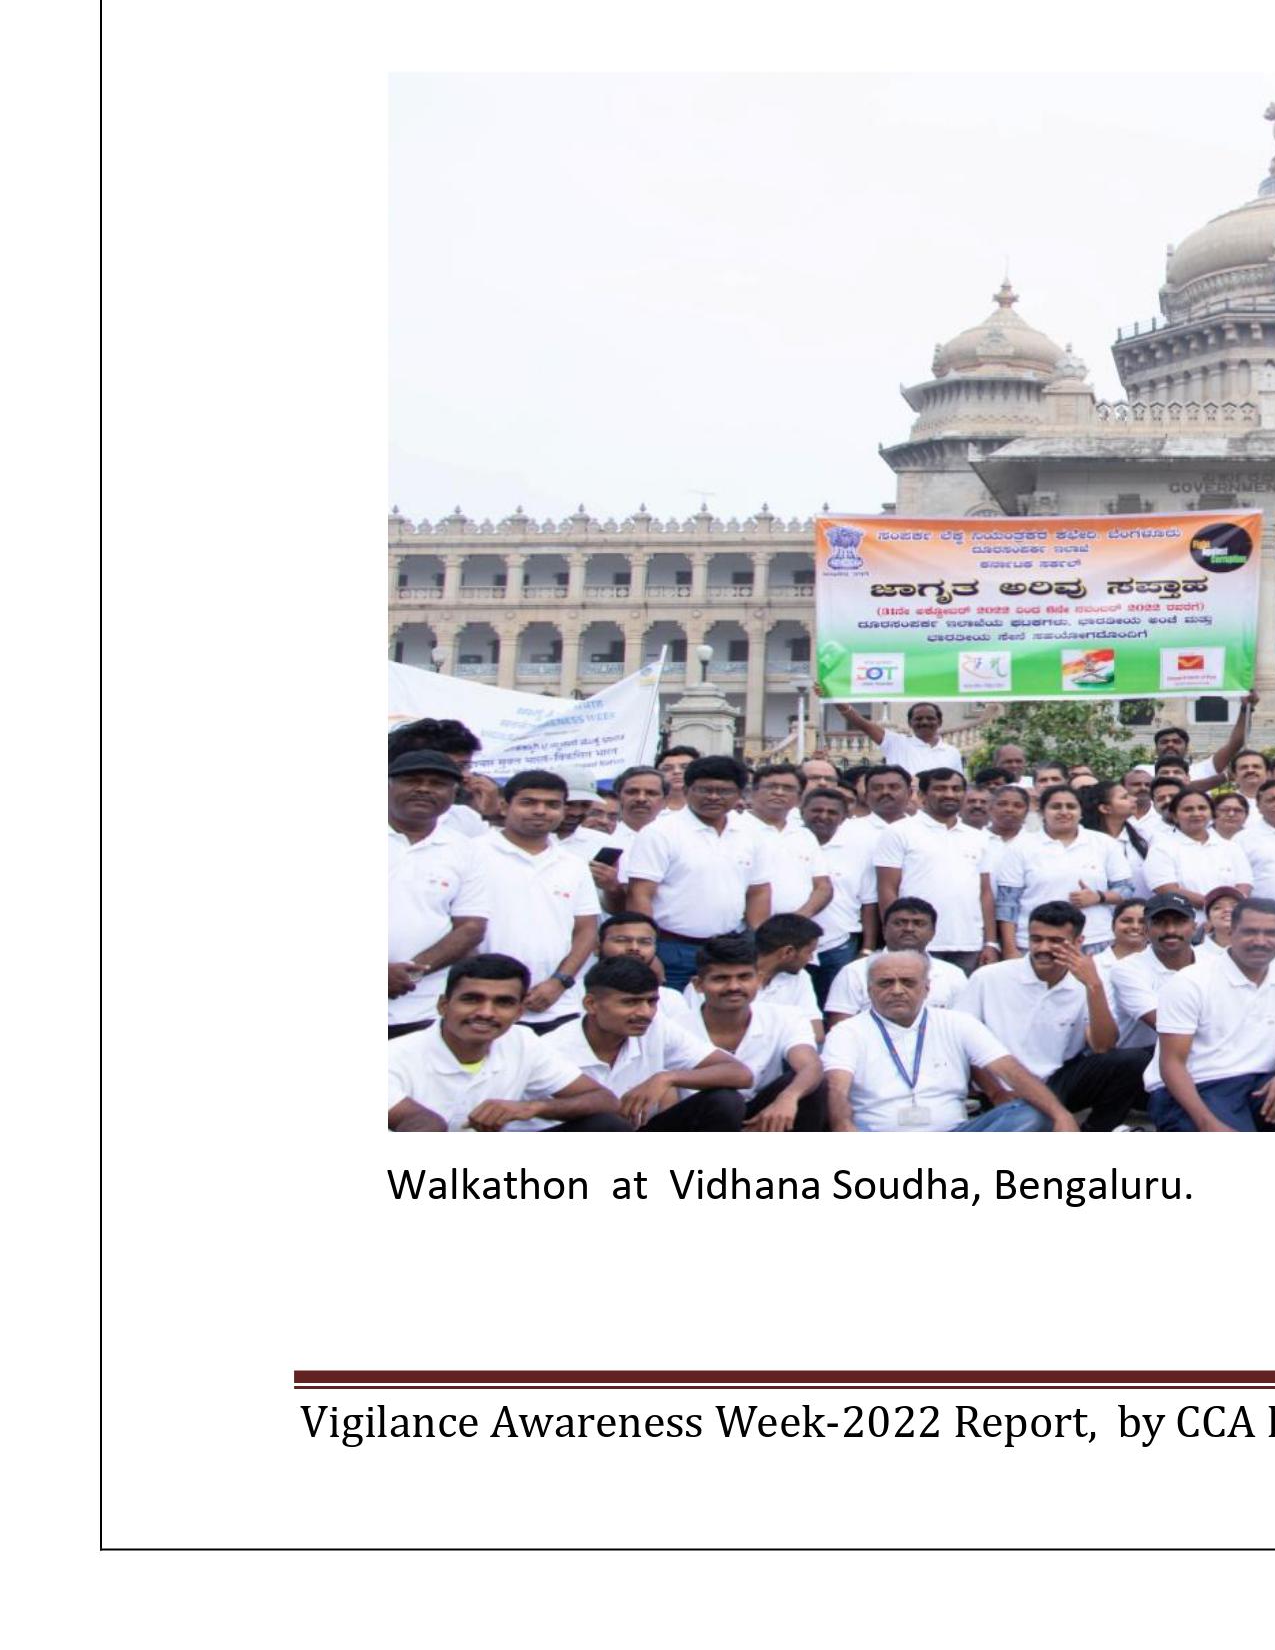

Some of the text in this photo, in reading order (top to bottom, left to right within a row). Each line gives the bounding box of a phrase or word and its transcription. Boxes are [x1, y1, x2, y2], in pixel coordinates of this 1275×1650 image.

[870, 576, 1209, 605] ಜಾಗೃತ ಅರಿವು ಸಪ್ತಾಹ
[387, 1168, 1191, 1207] Walkathon at Vidhana Soudha, Bengaluru.
[300, 1405, 478, 1447] Vigilance
[490, 1406, 701, 1437] Awareness
[715, 1405, 939, 1437] Week-2022
[956, 1406, 1095, 1447] Report,
[1118, 1405, 1165, 1447] by
[1178, 1406, 1255, 1437] CCA
